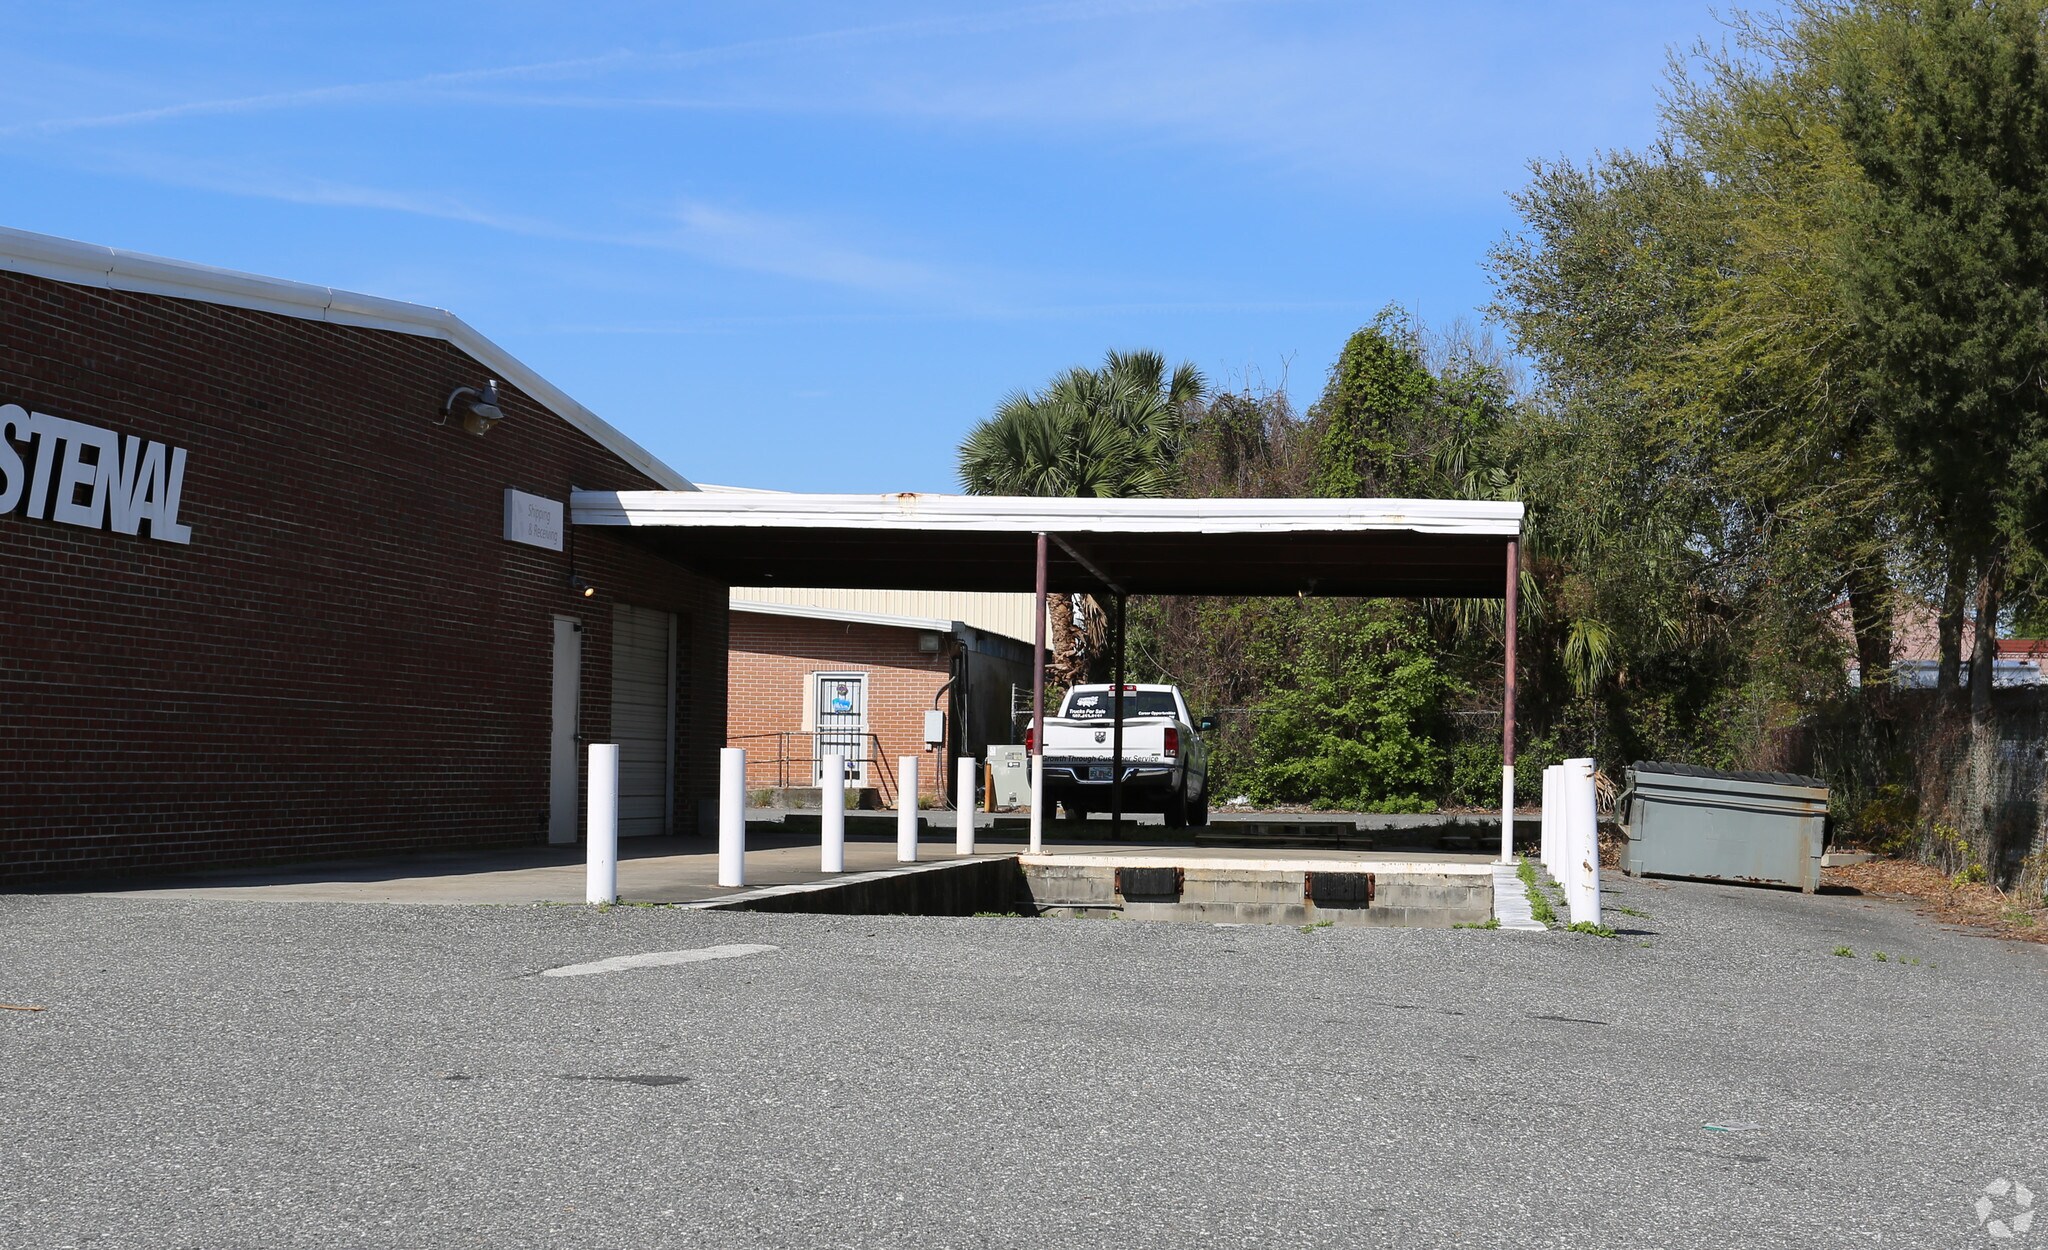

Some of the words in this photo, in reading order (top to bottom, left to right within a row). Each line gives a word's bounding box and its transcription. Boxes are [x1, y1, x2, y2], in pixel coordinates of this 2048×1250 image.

[528, 504, 551, 525] Shipping
[528, 522, 533, 536] &
[534, 524, 558, 545] Receiving
[1068, 755, 1096, 764] Through
[1133, 755, 1159, 763] Service
